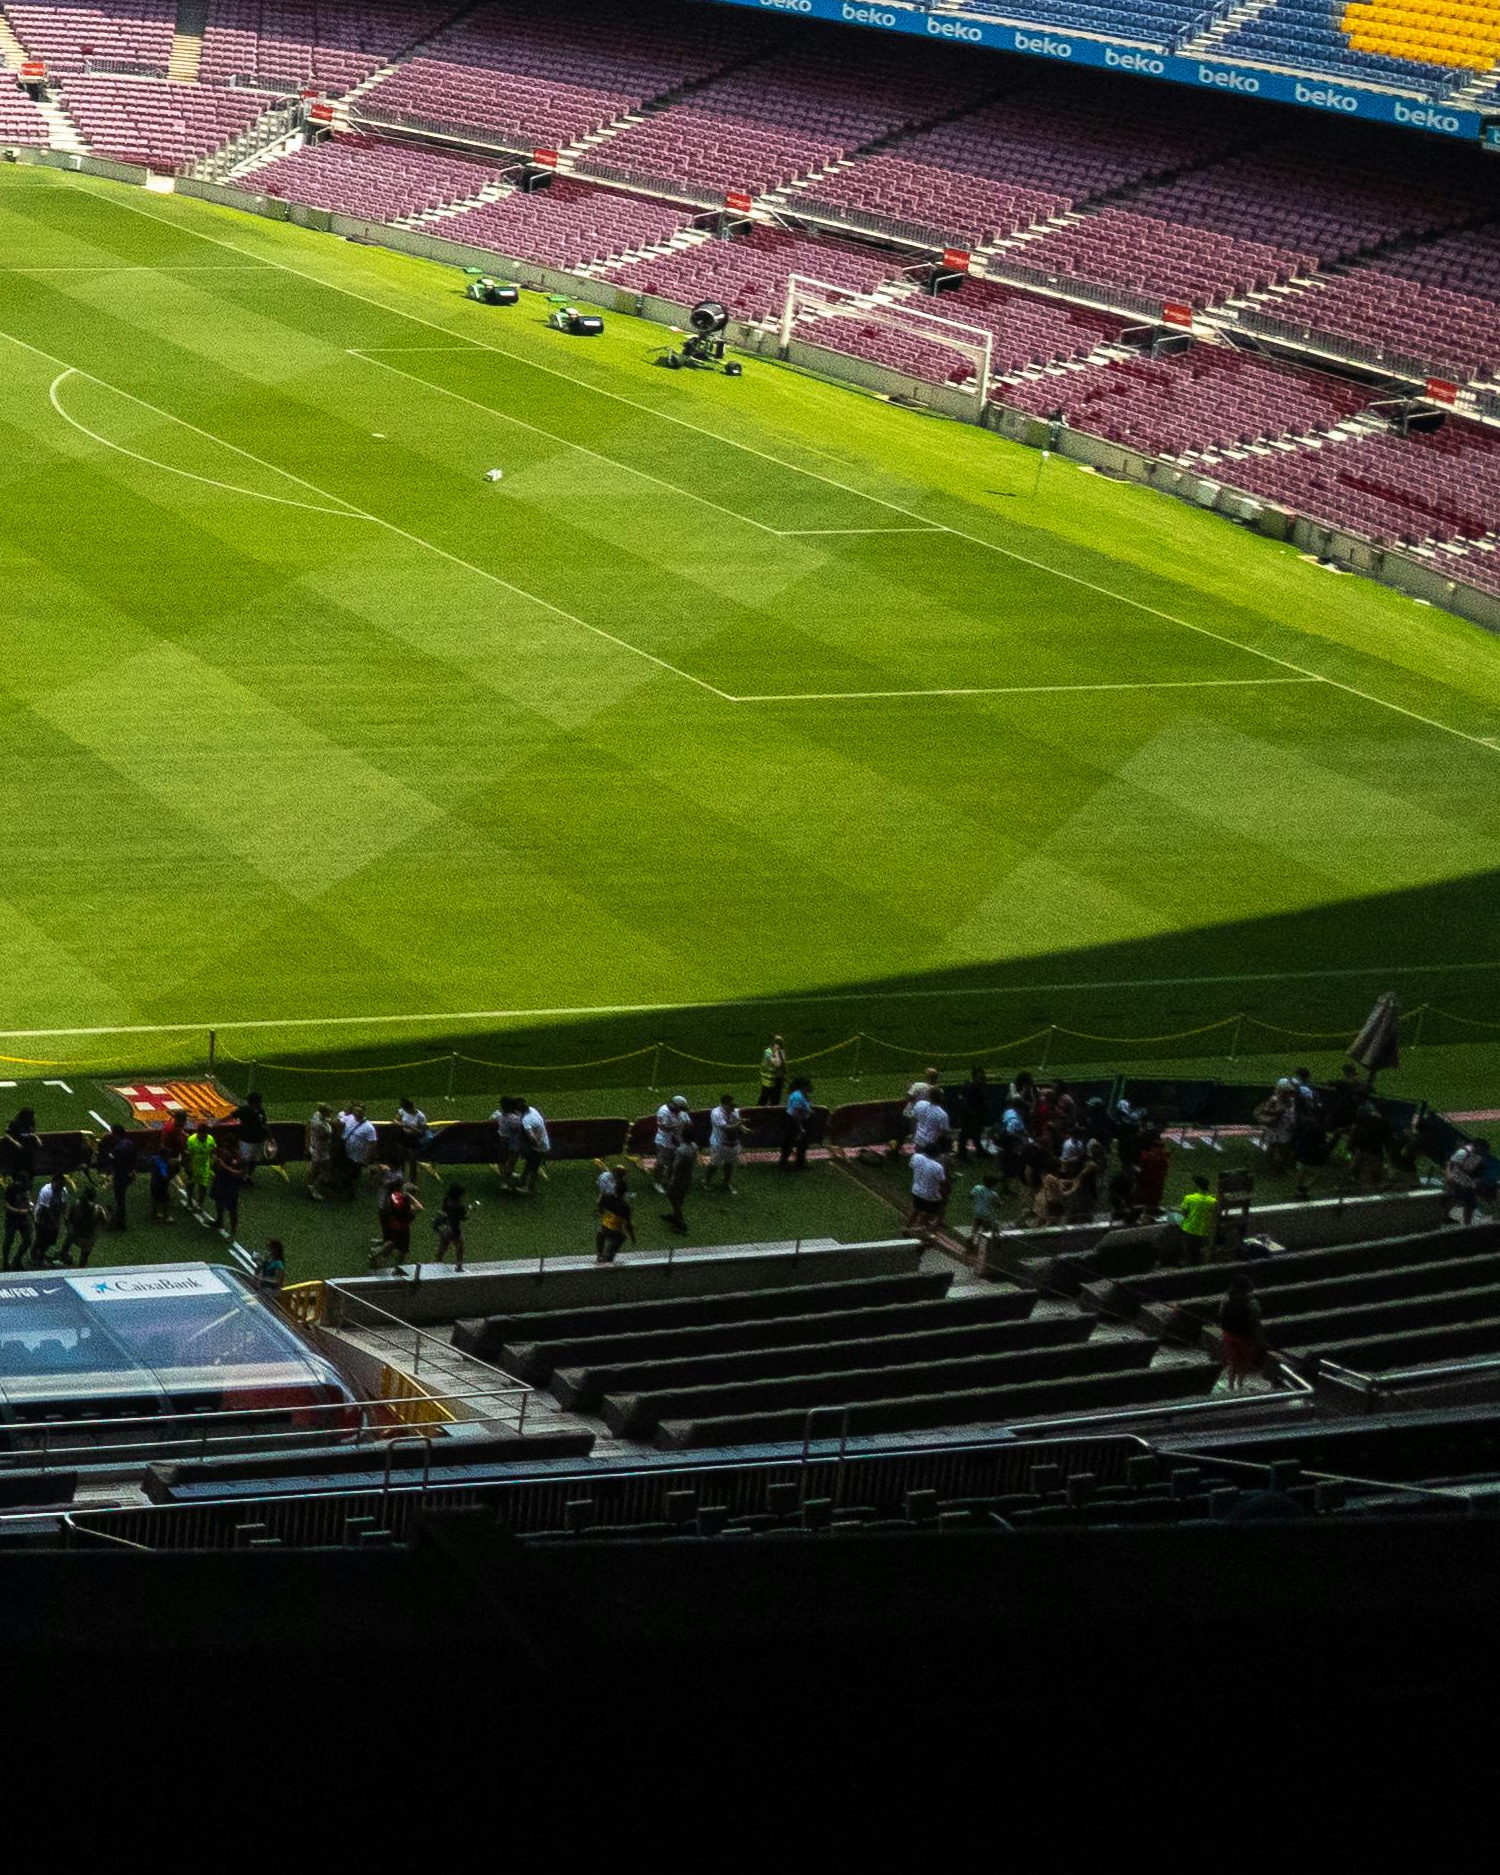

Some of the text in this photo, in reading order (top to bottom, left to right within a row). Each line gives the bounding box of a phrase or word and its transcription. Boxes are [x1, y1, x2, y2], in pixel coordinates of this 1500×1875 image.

[843, 4, 895, 26] beko
[928, 17, 981, 40] beko
[1015, 32, 1071, 57] beko
[1106, 49, 1164, 73] beko
[1200, 66, 1258, 91] beko
[1296, 84, 1357, 110] beko
[1396, 103, 1458, 131] beko
[115, 1277, 202, 1294] CaixaBank
